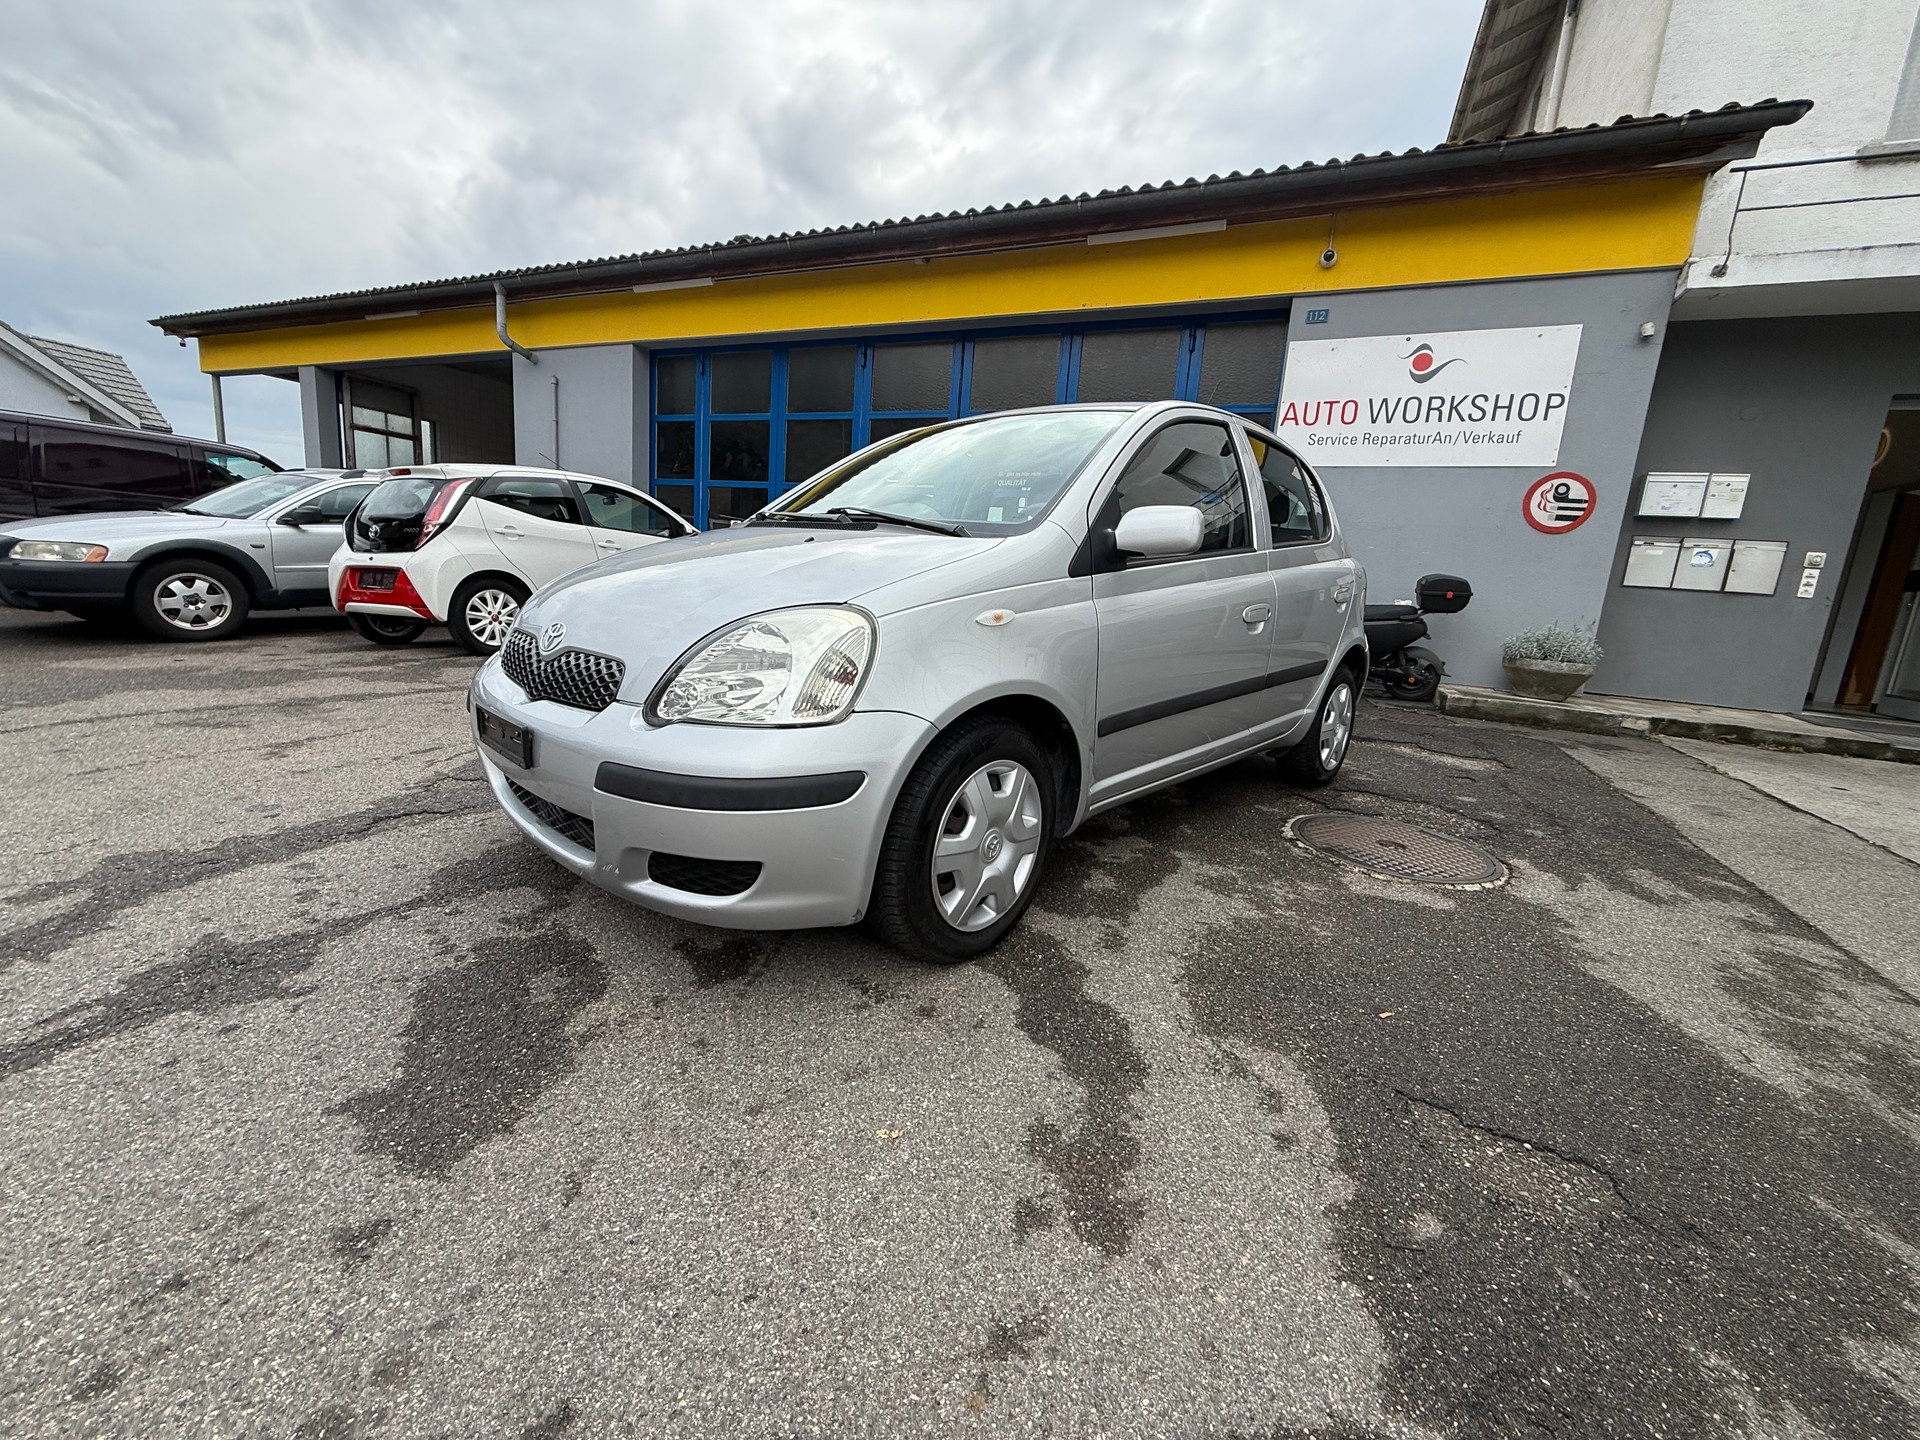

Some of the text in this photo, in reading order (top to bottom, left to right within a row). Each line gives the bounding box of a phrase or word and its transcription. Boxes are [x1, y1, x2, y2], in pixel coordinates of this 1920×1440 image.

[1309, 311, 1326, 321] 112
[1280, 393, 1566, 426] AUTO WORKSHOP
[1308, 432, 1358, 446] Service
